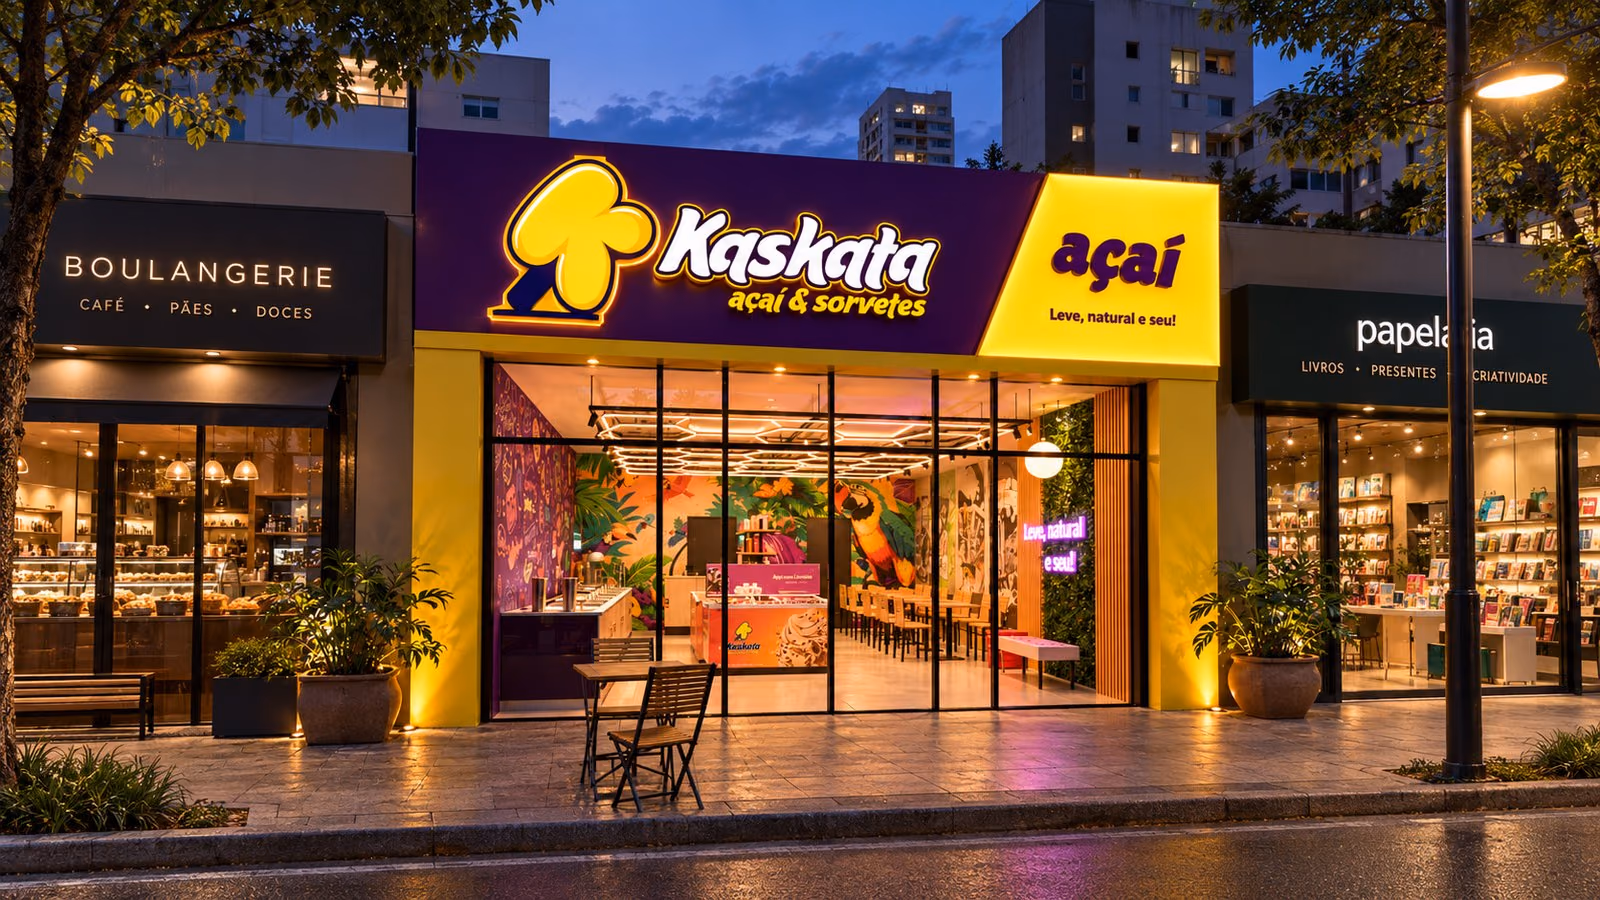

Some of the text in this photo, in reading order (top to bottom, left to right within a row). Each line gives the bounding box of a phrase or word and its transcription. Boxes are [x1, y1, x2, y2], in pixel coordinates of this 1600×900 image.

[655, 204, 940, 294] Kaskata
[1051, 232, 1185, 293] açaí
[65, 255, 333, 288] BOULANGERIE
[79, 296, 125, 312] CAFÉ
[256, 305, 313, 320] DOCES
[728, 287, 926, 319] açaí & sorvetes
[1050, 308, 1176, 326] Leve, natural e seu!
[1357, 315, 1494, 353] papelia
[1301, 361, 1548, 385] LIVROS PRESENTES CRIATIVIDADE
[1047, 516, 1086, 539] natural
[1044, 556, 1052, 572] e
